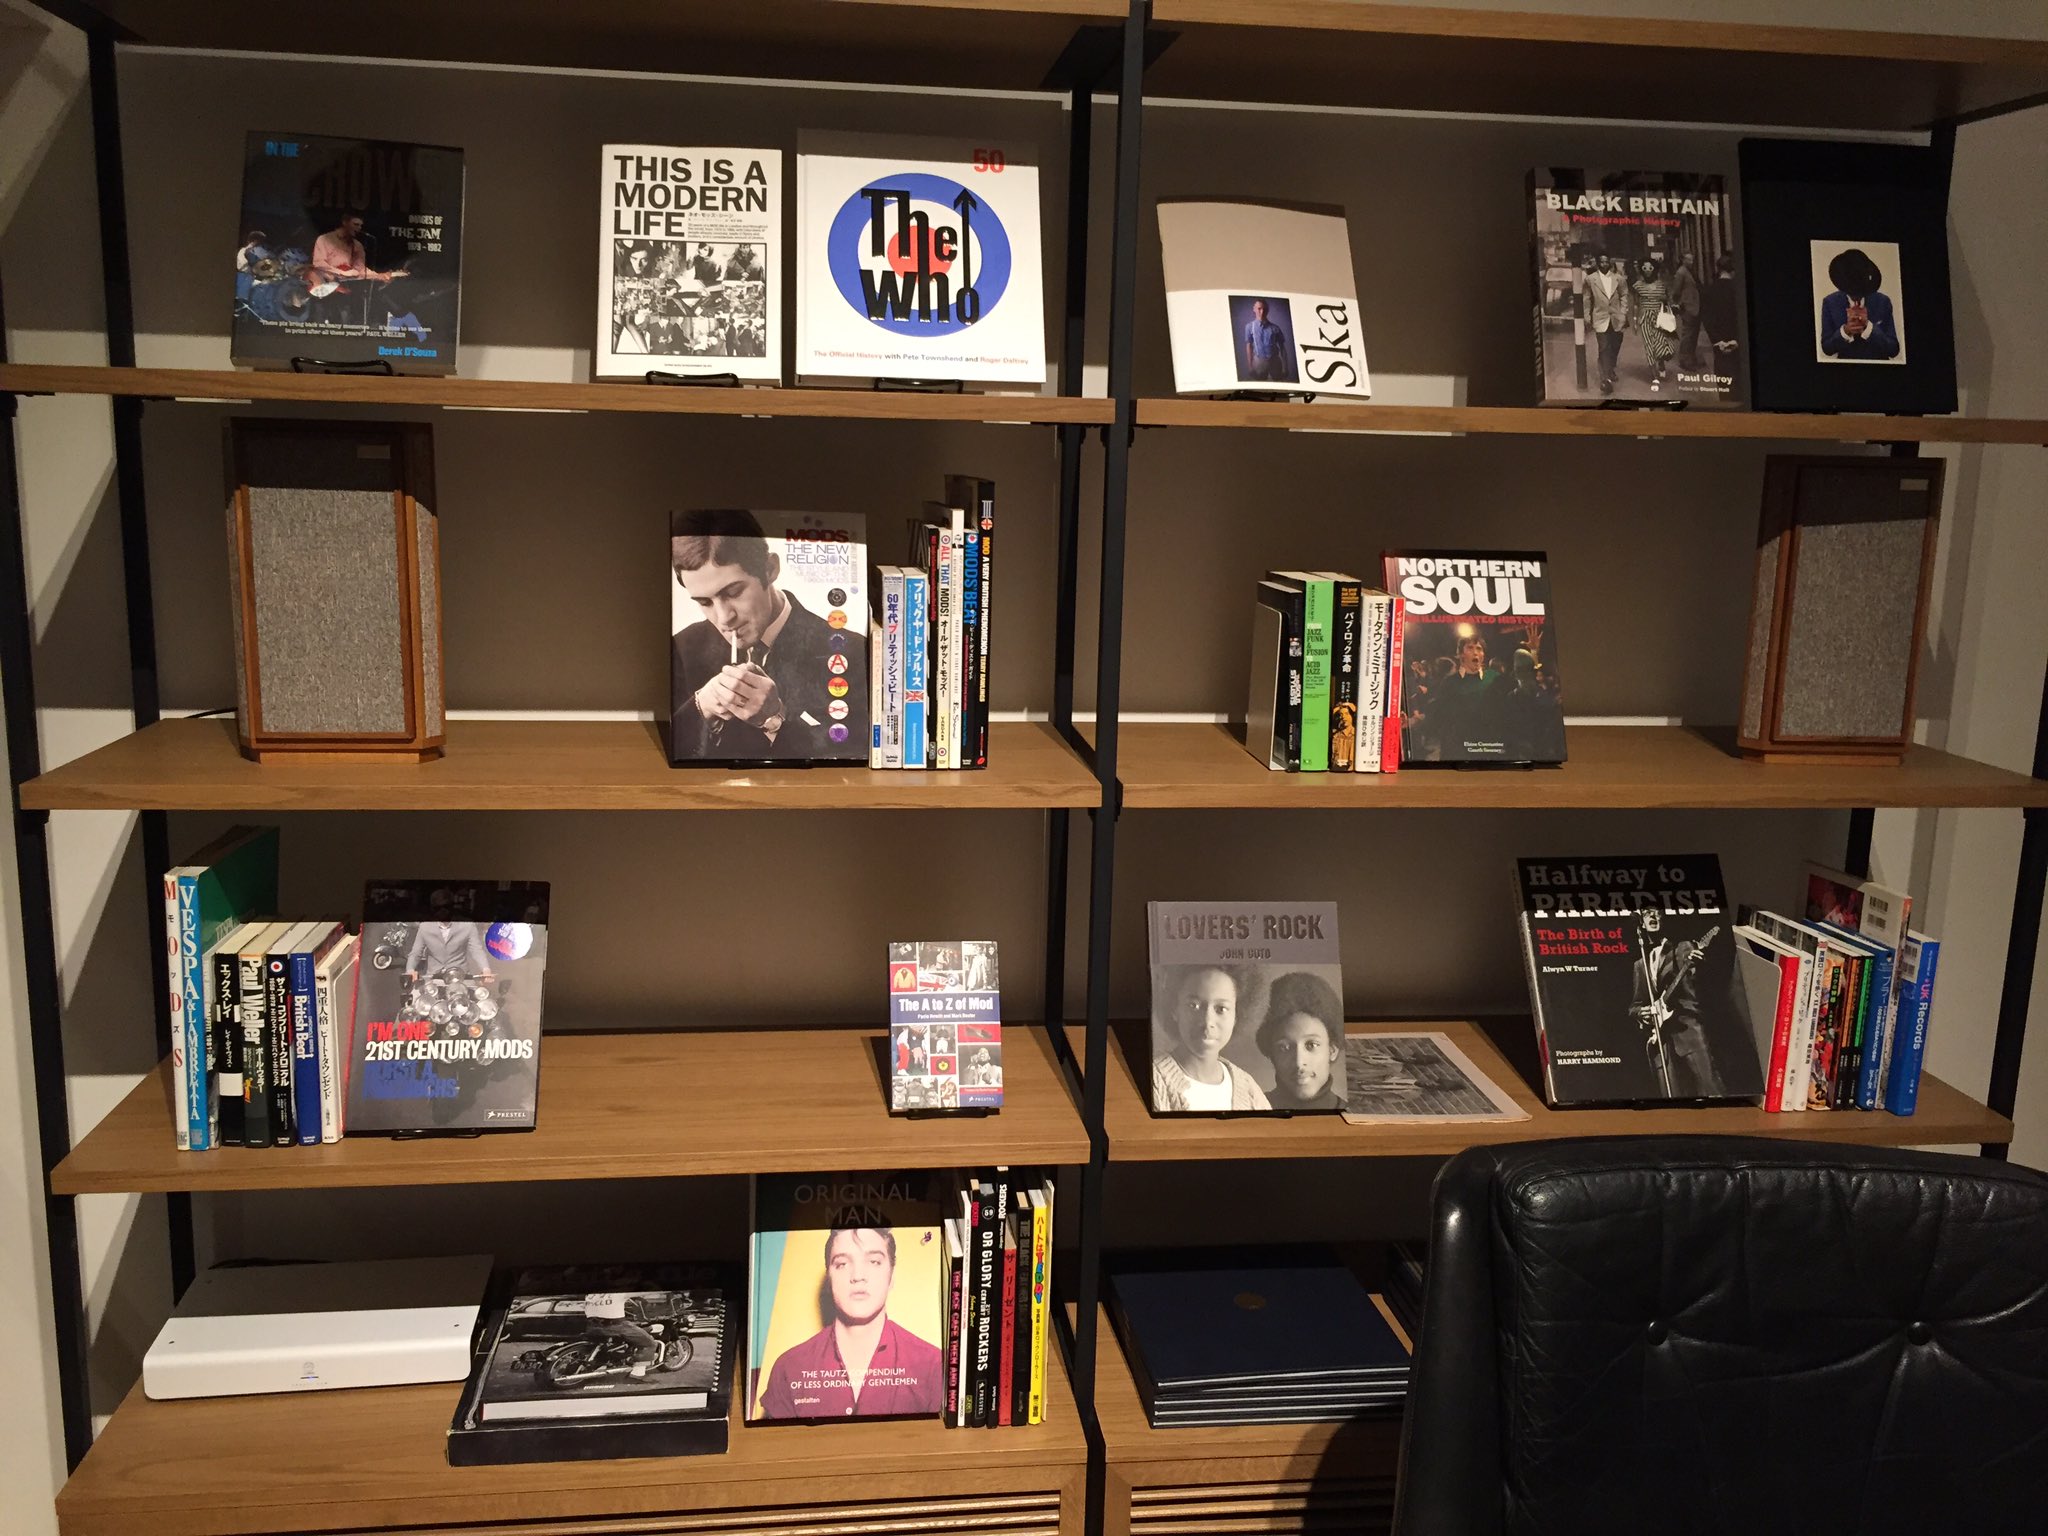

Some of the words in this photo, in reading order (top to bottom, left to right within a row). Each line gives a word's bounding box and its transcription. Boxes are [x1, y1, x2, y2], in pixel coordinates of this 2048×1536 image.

[613, 154, 693, 184] THIS
[704, 158, 735, 185] IS
[743, 160, 768, 186] A
[973, 150, 1005, 173] 50
[614, 182, 768, 213] MODERN
[1545, 193, 1622, 213] BLACK
[1629, 196, 1720, 216] BRITAIN
[613, 209, 686, 238] LIFE
[1572, 214, 1641, 226] Photographic
[388, 226, 415, 239] THE
[417, 229, 443, 241] JAM
[1299, 300, 1358, 388] Ska
[814, 350, 828, 358] The
[829, 351, 856, 359] Official
[921, 354, 963, 363] Townshend
[1677, 373, 1700, 383] Paul
[1702, 374, 1733, 386] Gilroy
[785, 528, 850, 543] MODS
[981, 536, 991, 555] MOD
[785, 543, 813, 554] THE
[816, 544, 849, 555] NEW
[940, 545, 950, 561] ALL
[940, 563, 950, 586] THAT
[981, 562, 990, 580] VERY
[1397, 557, 1542, 578] NORTHERN
[939, 587, 950, 617] MODS!
[980, 580, 990, 608] BRITISH
[1400, 576, 1546, 616] SOUL
[1423, 615, 1496, 625] ILLUSTRATED
[1497, 615, 1546, 625] HISTORY
[1306, 635, 1324, 643] FUNK
[1369, 603, 1385, 711] モータウン・ミュージック
[1526, 864, 1649, 891] Halfway
[1656, 864, 1686, 884] to
[1531, 889, 1721, 919] PARADISE
[1262, 913, 1325, 941] ROCK
[1536, 928, 1564, 941] The
[1567, 928, 1605, 941] Birth
[1608, 928, 1623, 939] of
[179, 885, 201, 1000] VESPA
[1539, 942, 1589, 956] British
[1592, 941, 1630, 955] Rock
[1219, 948, 1245, 960] JOHN
[240, 956, 264, 990] Paul
[1542, 965, 1564, 974] Alwyn
[219, 963, 232, 1019] エックス・レイ
[186, 1000, 197, 1012] &
[294, 995, 309, 1033] British
[898, 998, 920, 1012] The
[921, 998, 931, 1011] A
[932, 999, 943, 1011] to
[944, 997, 954, 1010] Z
[954, 998, 967, 1010] of
[968, 997, 994, 1011] Mod
[242, 992, 266, 1045] Weller
[1912, 1002, 1929, 1051] Records
[366, 1022, 394, 1042] I'M
[396, 1020, 431, 1041] ONE
[295, 1033, 315, 1060] Beat
[364, 1041, 405, 1061] 21ST
[406, 1039, 480, 1061] CENTURY
[482, 1038, 534, 1061] MODS
[1555, 1049, 1595, 1058] Photographs
[188, 1011, 201, 1121] LAMBRETTA
[1557, 1058, 1581, 1066] HARRY
[1582, 1057, 1622, 1065] HAMMOND
[495, 1110, 536, 1120] PRESTEL
[794, 1183, 916, 1205] ORIGINAL
[825, 1205, 885, 1227] MAN
[982, 1231, 994, 1248] OR
[980, 1249, 993, 1288] GLORY
[951, 1291, 960, 1309] ACE
[950, 1312, 960, 1337] CAFE
[977, 1316, 991, 1372] ROCKERS
[790, 1381, 803, 1390] OF
[804, 1380, 822, 1389] LESS
[867, 1377, 918, 1387] GENTLEMEN
[801, 1370, 819, 1379] THE
[819, 1369, 847, 1378] TAUTZ
[949, 1367, 959, 1387] AND
